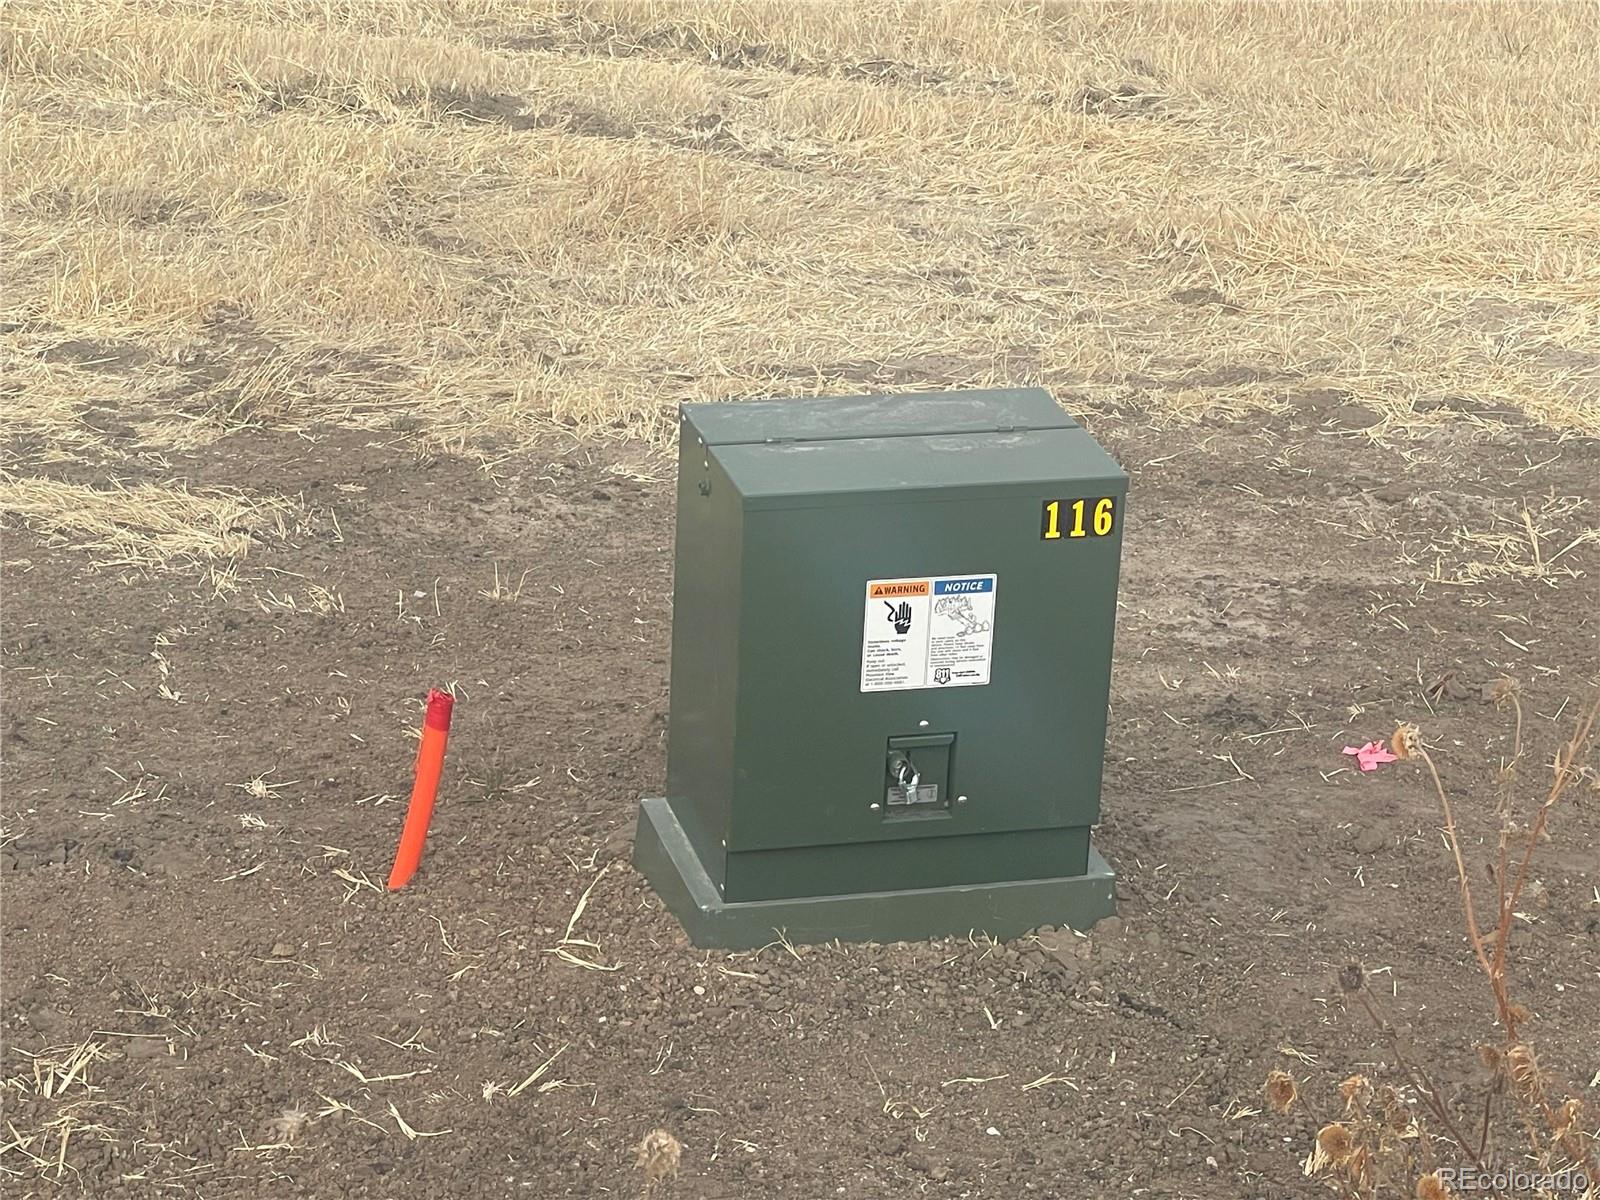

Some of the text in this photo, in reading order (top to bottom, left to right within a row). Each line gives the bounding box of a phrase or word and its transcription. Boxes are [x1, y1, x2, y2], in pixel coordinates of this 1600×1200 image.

[1044, 498, 1113, 539] 116
[884, 585, 926, 595] WARNING
[944, 581, 984, 592] NOTICE
[936, 668, 950, 679] 811
